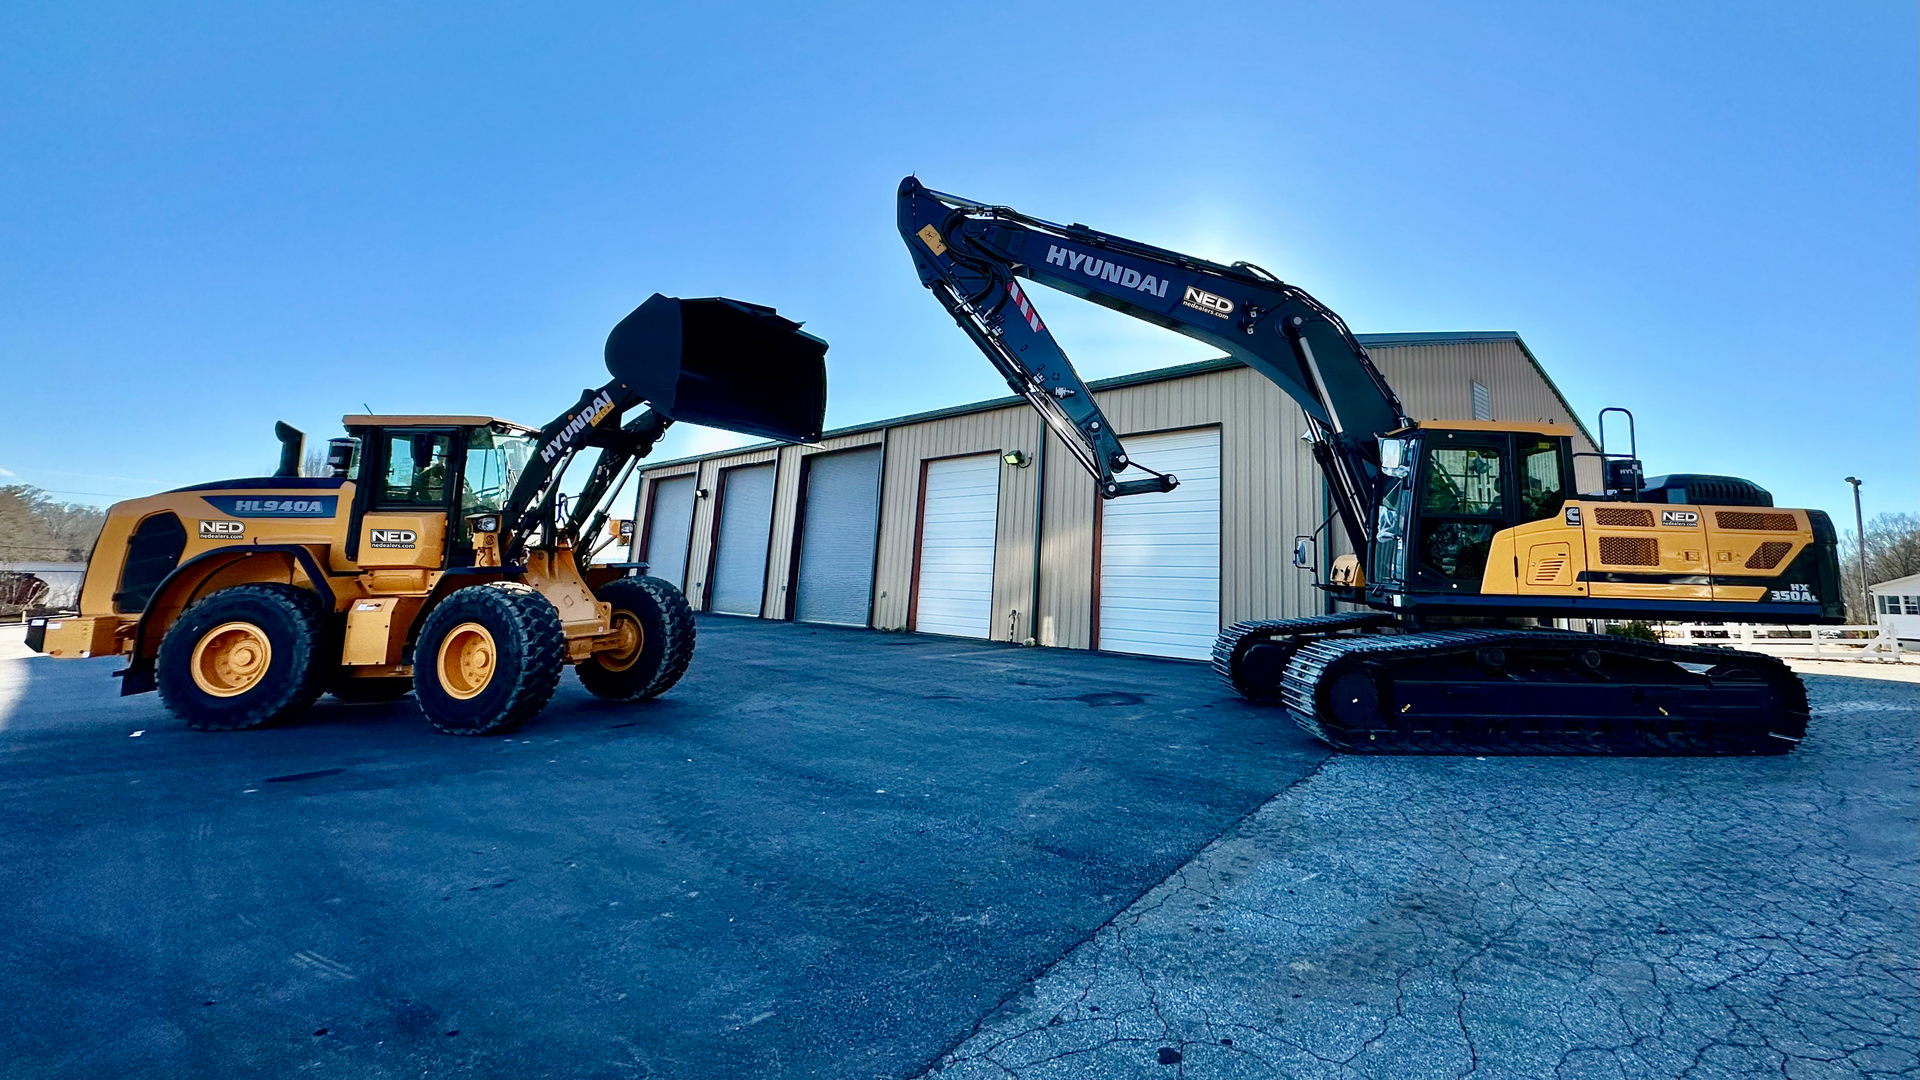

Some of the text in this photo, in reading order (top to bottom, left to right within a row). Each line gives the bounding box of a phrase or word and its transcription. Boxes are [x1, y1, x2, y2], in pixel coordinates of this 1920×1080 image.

[1045, 245, 1169, 298] HYUNDAI
[1186, 288, 1233, 312] NED
[1182, 301, 1229, 320] nedealers.com
[540, 390, 612, 463] HYUNDAI
[235, 500, 322, 513] HL940A
[1663, 512, 1698, 522] NED
[200, 522, 244, 534] NED
[372, 531, 416, 542] NED
[1790, 583, 1809, 591] HX
